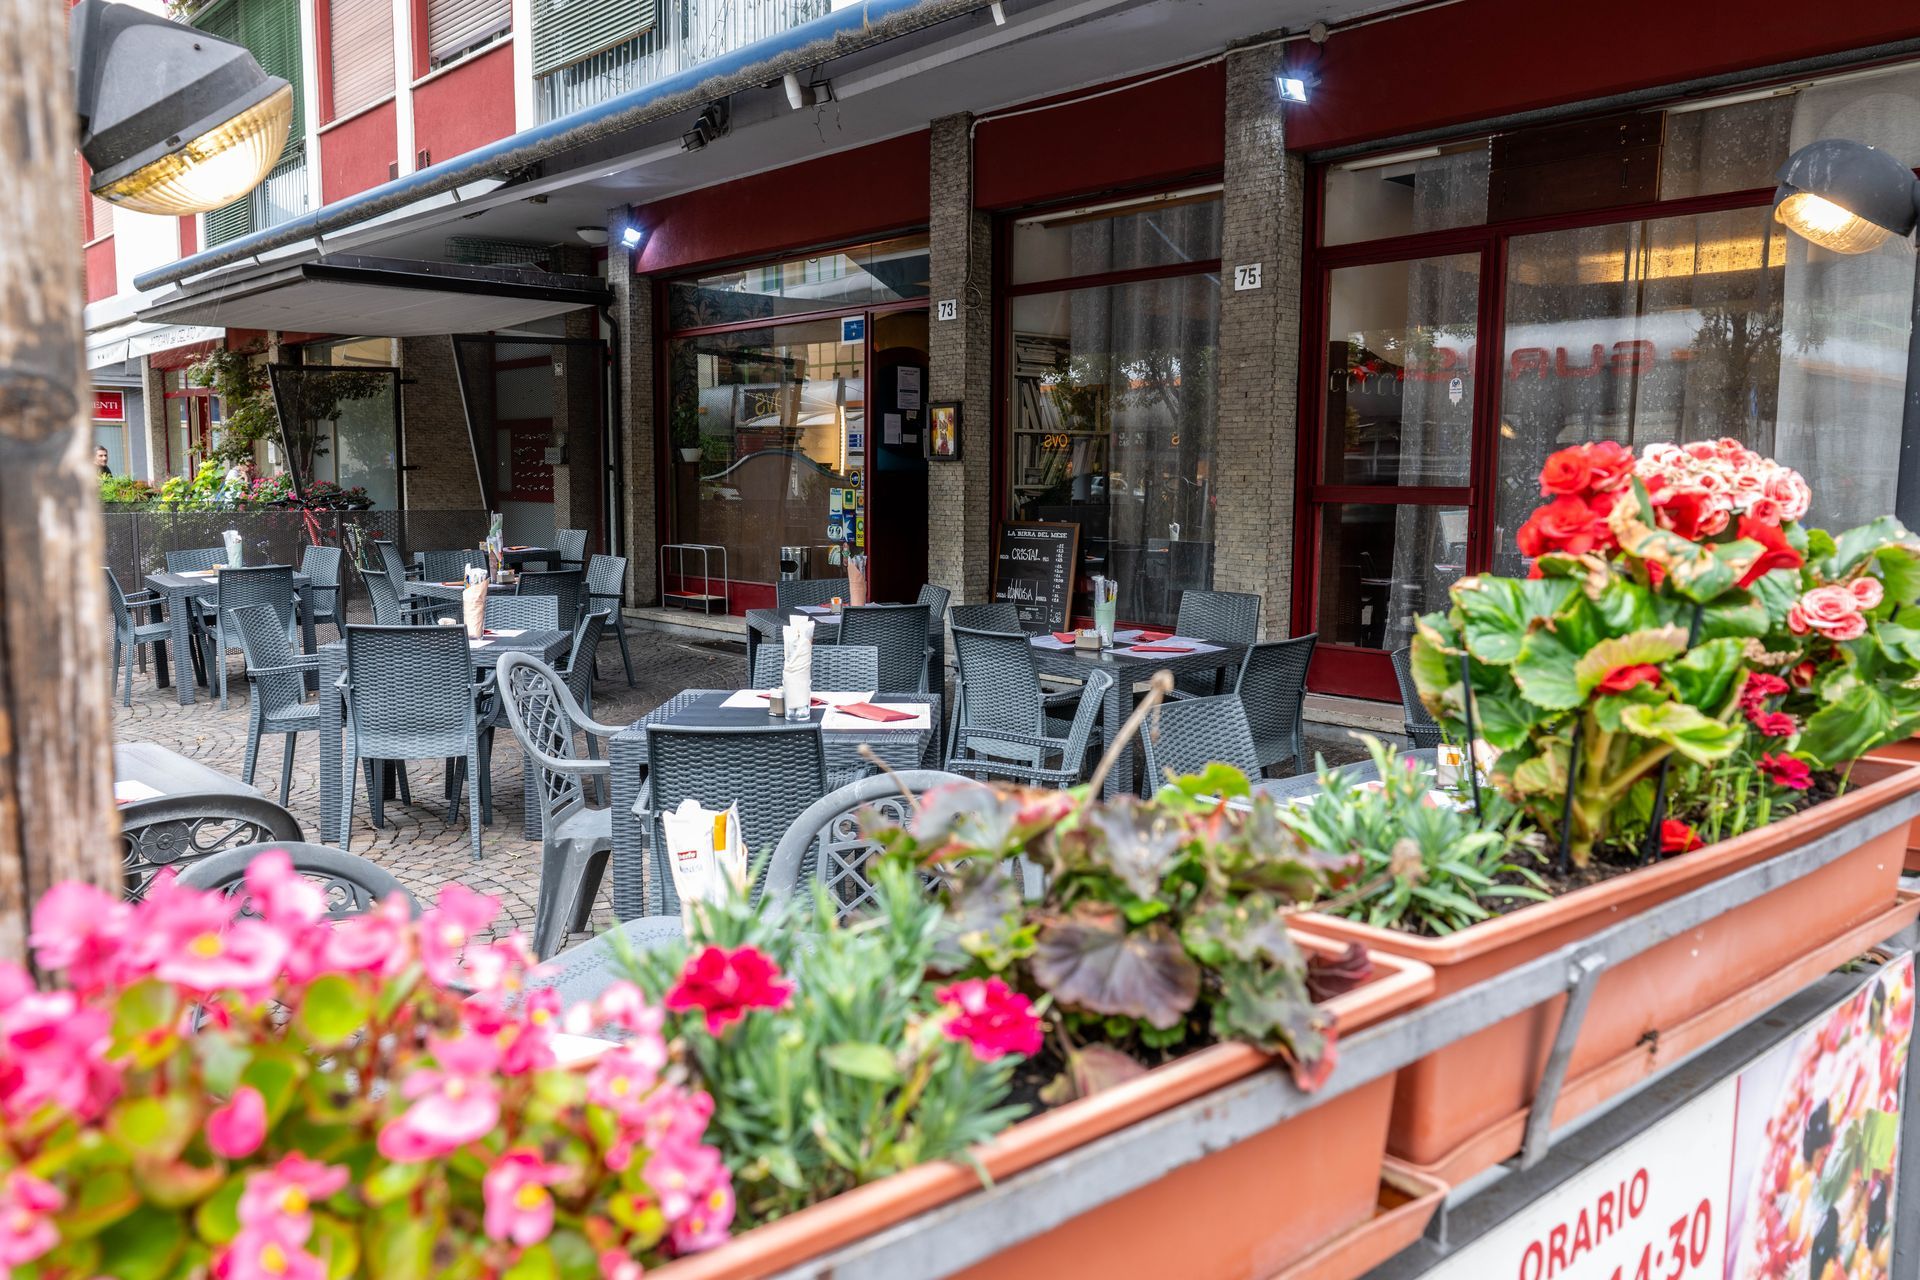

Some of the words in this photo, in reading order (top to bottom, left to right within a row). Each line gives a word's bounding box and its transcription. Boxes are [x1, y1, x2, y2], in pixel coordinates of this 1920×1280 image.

[1239, 267, 1257, 286] 75
[940, 302, 954, 318] 73
[1519, 1167, 1649, 1280] ORARIO
